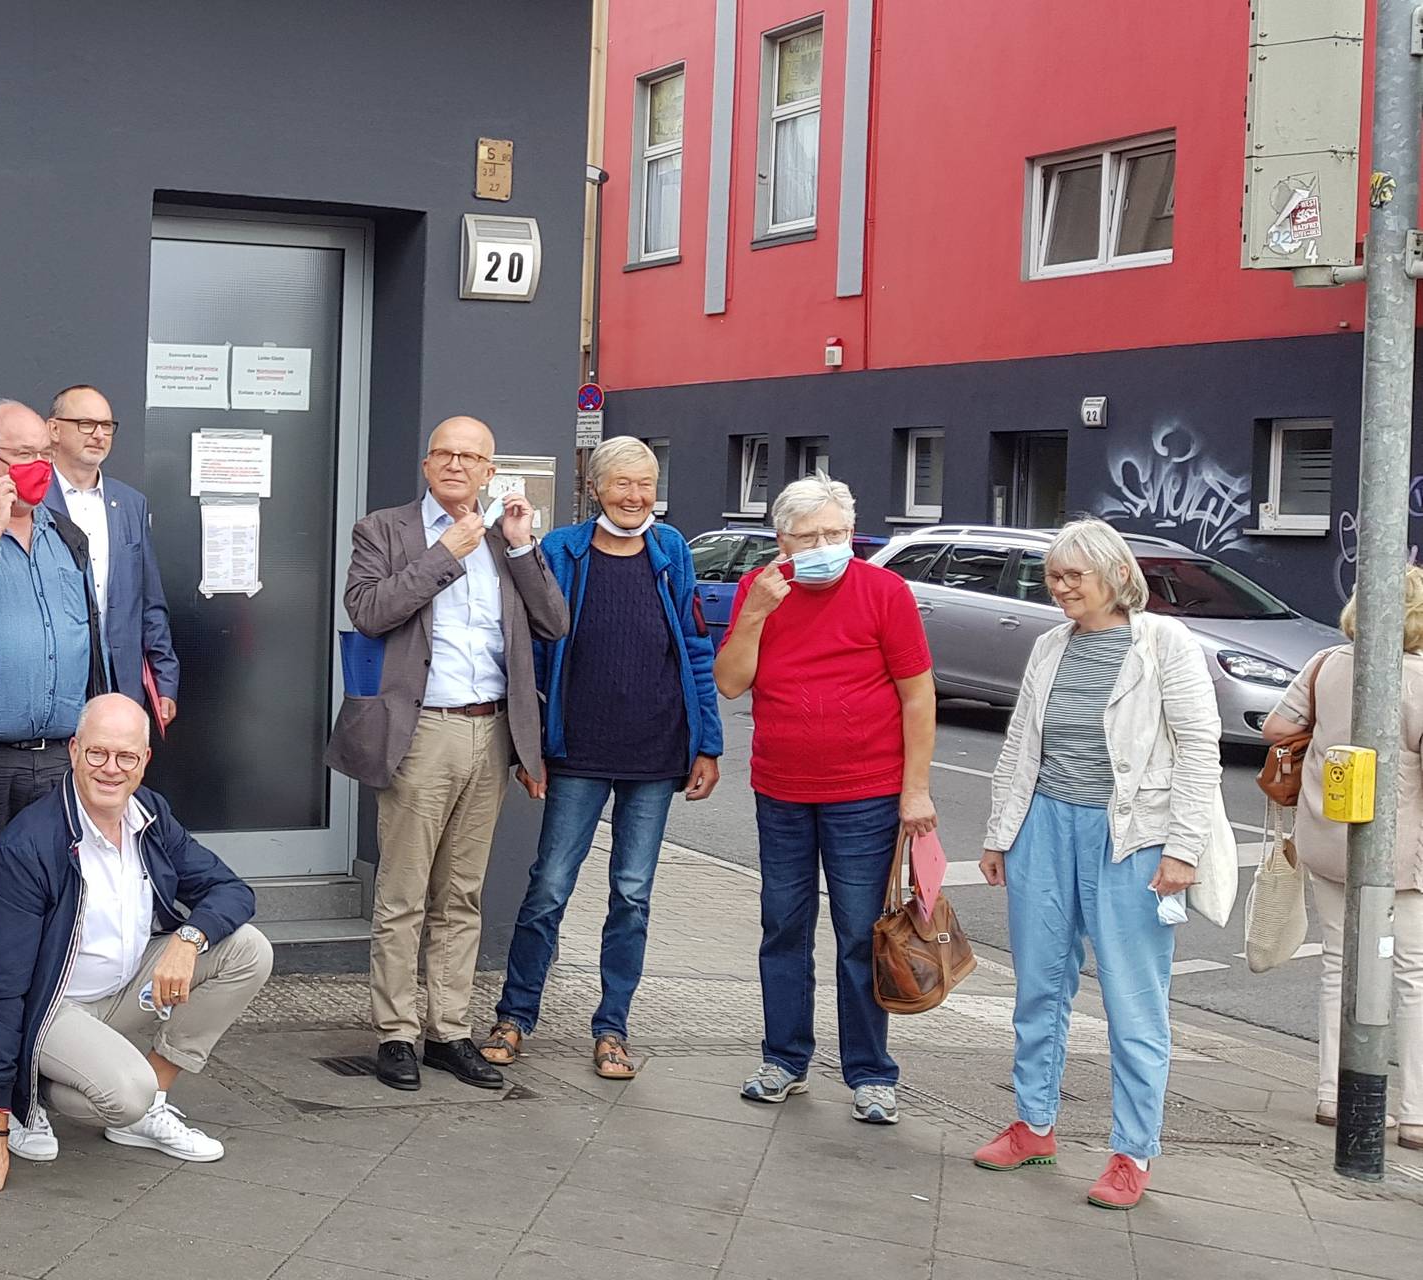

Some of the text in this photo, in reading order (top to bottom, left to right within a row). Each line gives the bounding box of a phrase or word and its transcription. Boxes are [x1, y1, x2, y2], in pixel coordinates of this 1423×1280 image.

[487, 147, 496, 160] S
[1305, 240, 1319, 264] 4
[485, 252, 524, 283] 20
[1086, 410, 1098, 422] 22
